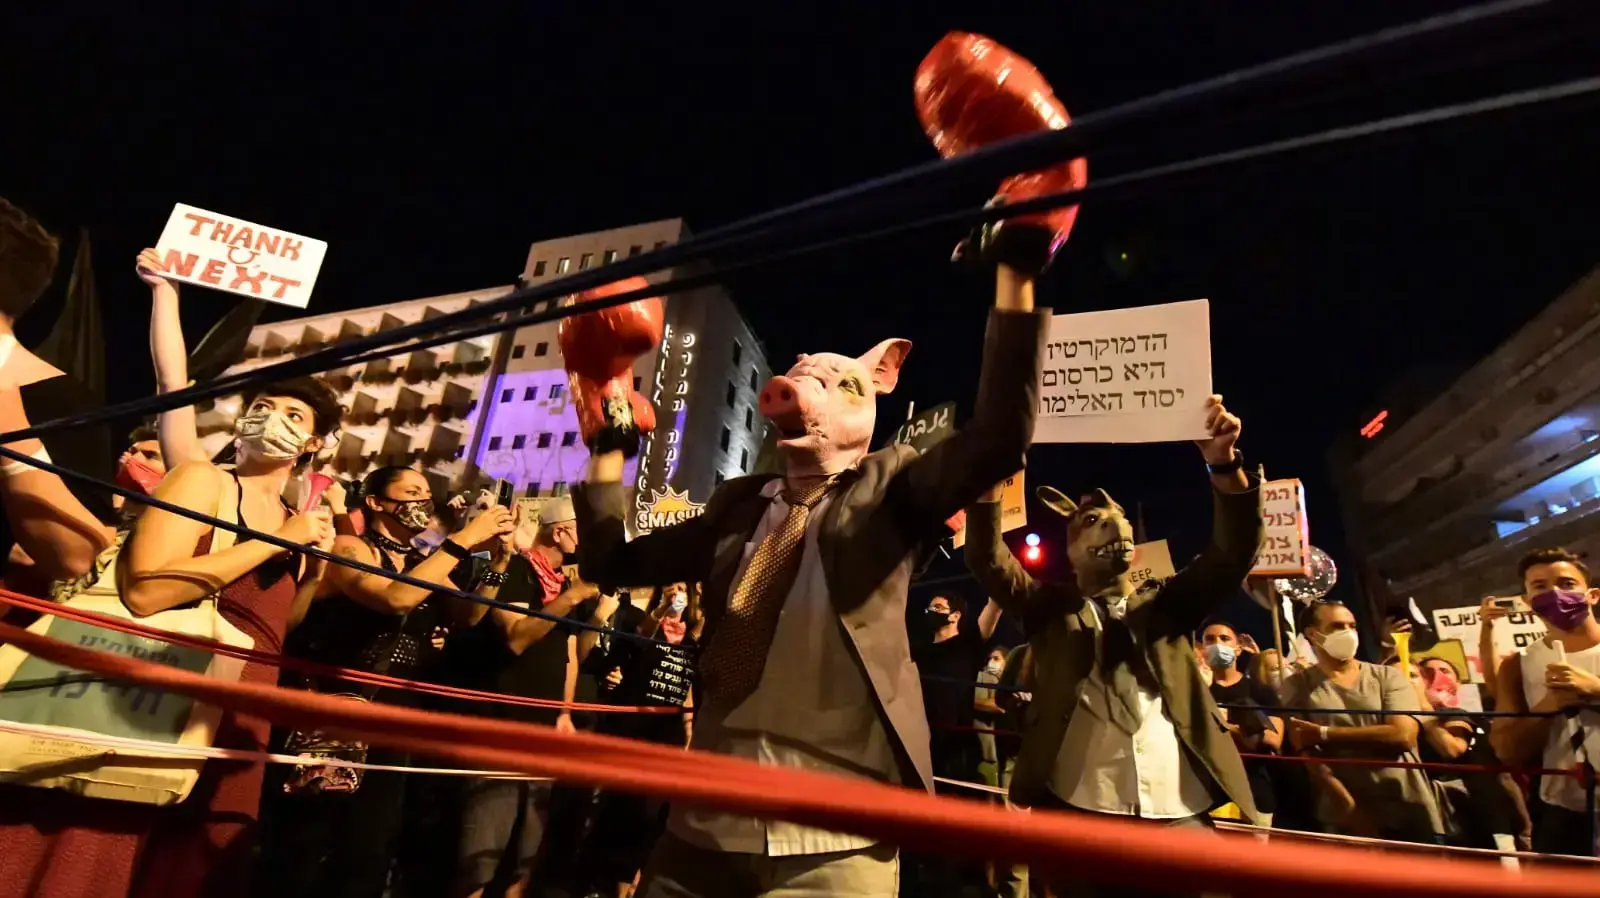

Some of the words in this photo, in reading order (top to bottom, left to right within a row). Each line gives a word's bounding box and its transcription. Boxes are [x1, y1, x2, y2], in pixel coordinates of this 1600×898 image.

[185, 213, 303, 261] THANK
[161, 249, 301, 298] NEXT
[1042, 365, 1113, 387] כרסום
[1124, 361, 1165, 382] היא
[1038, 389, 1123, 414] האלימו
[1133, 388, 1185, 409] יסוד
